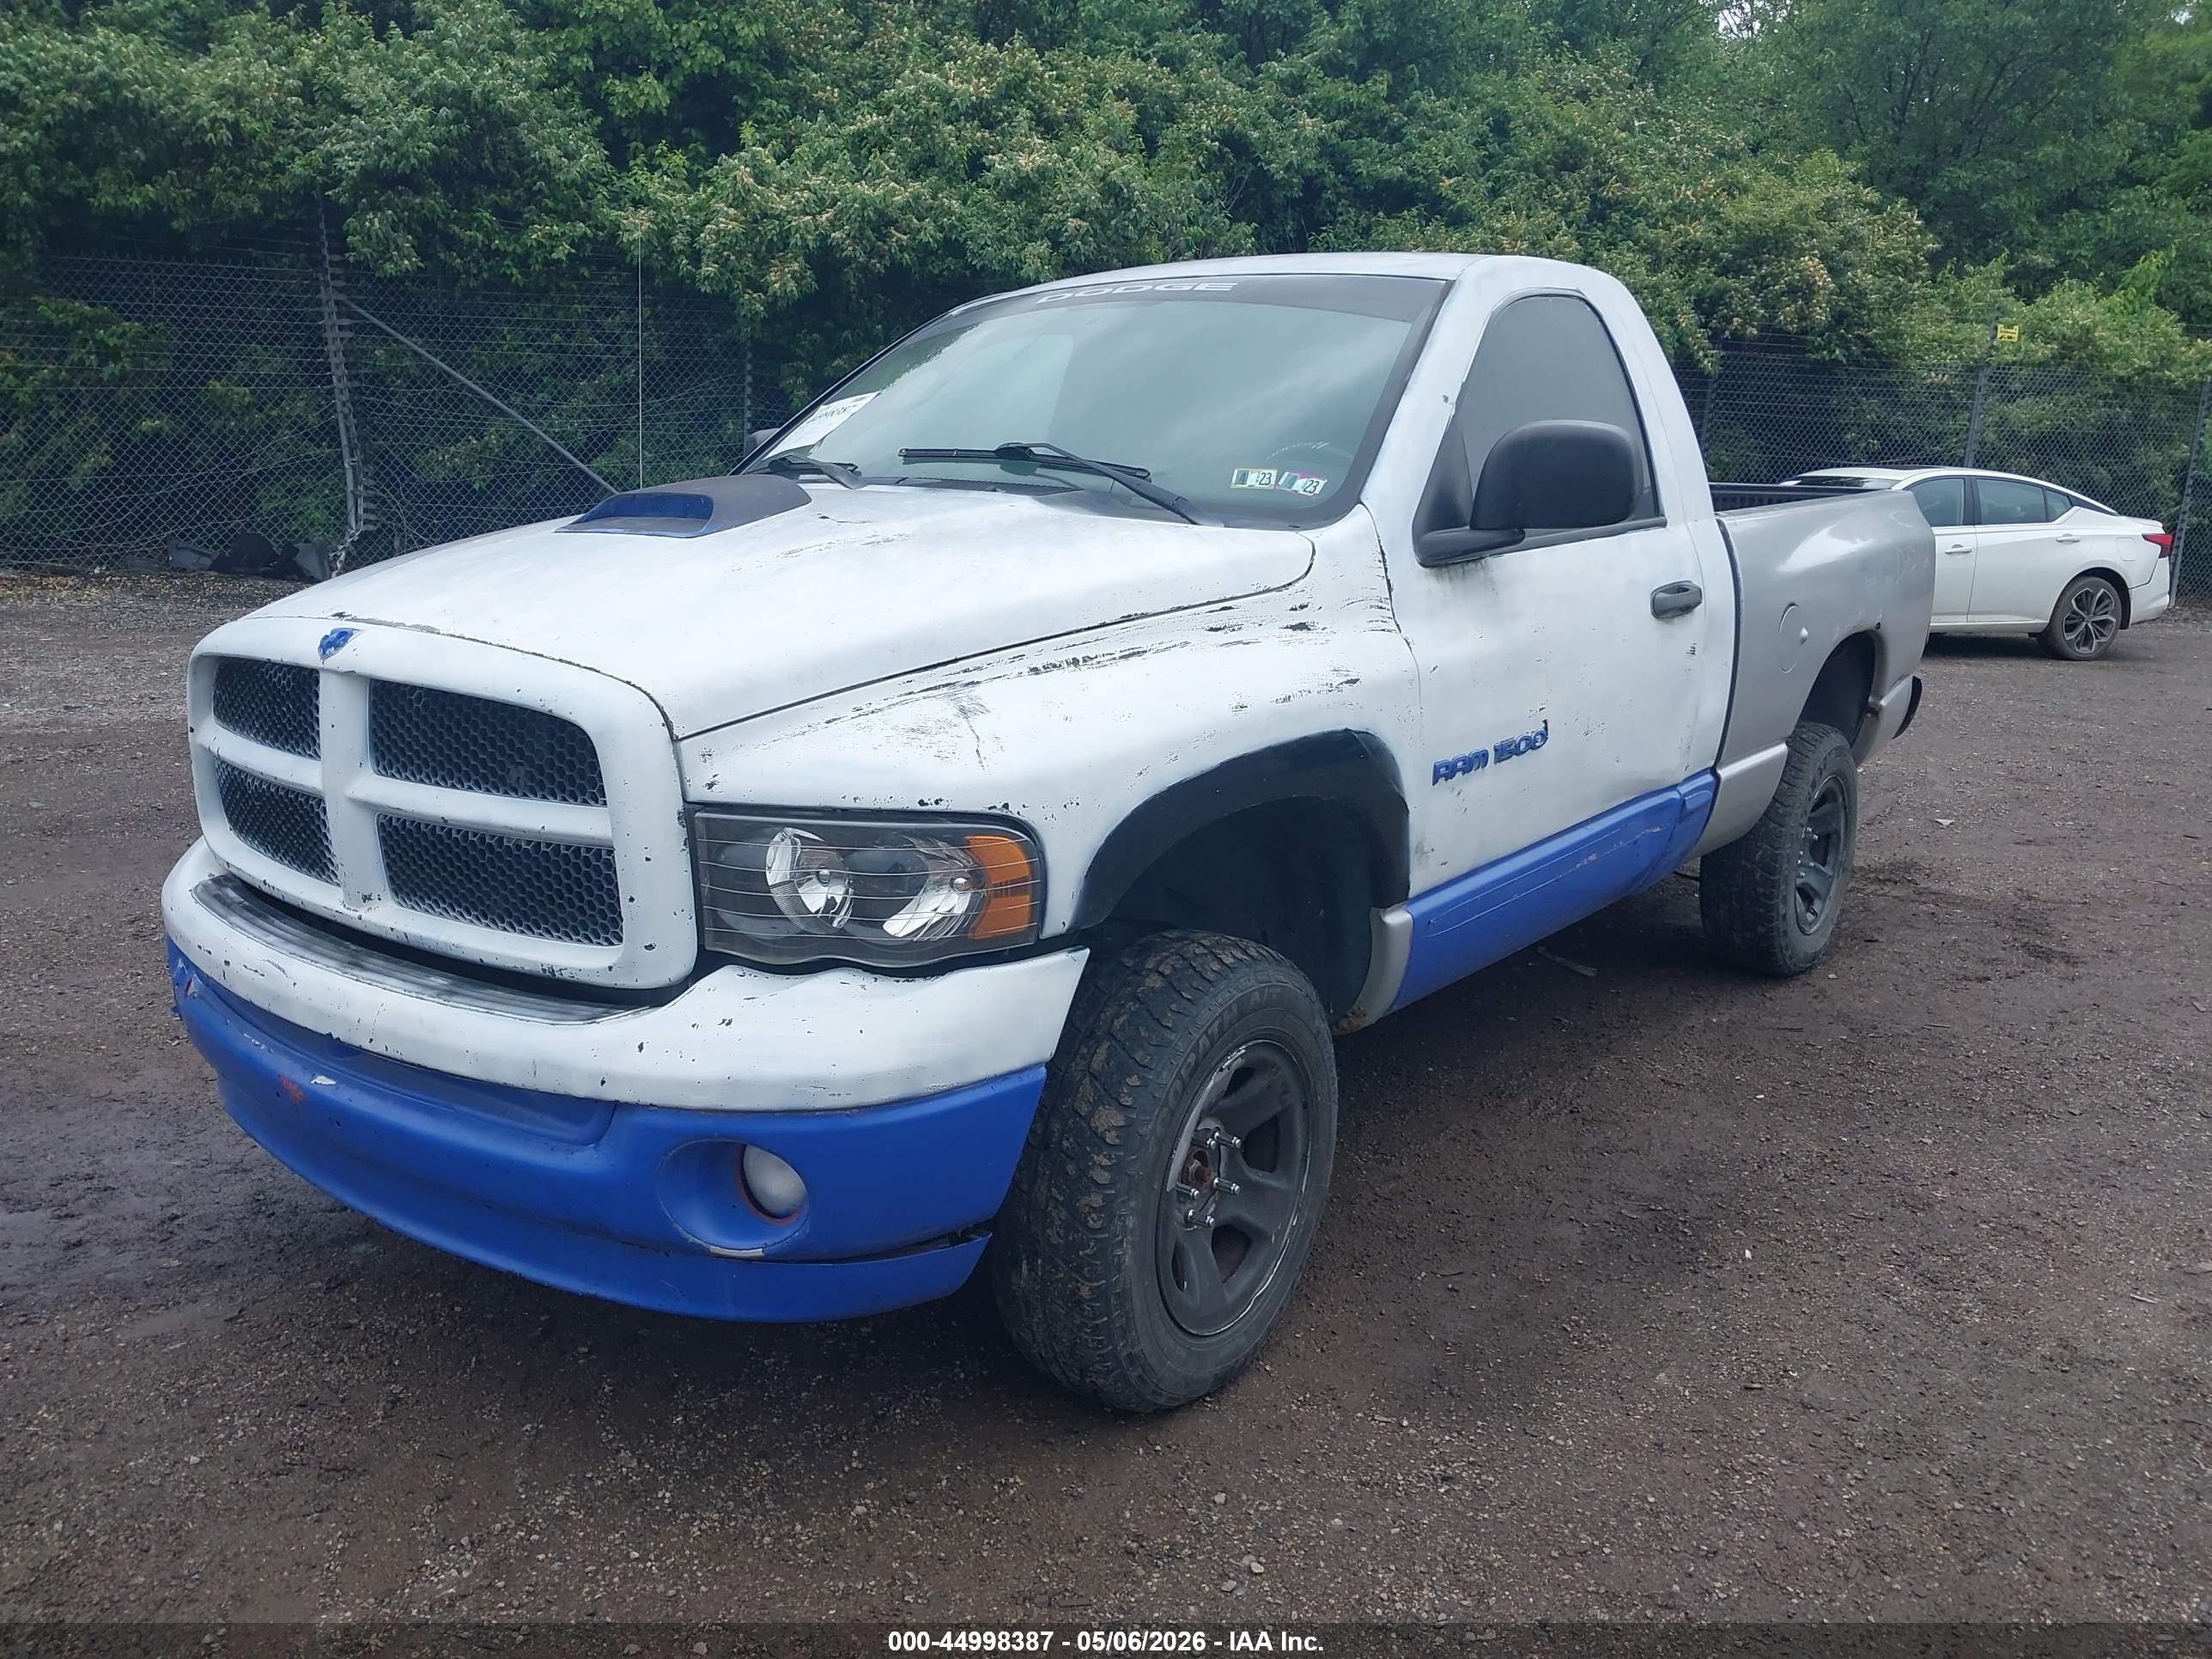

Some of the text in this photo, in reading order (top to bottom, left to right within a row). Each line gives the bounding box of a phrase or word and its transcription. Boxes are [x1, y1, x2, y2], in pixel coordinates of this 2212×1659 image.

[1036, 283, 1237, 304] DODGE
[1303, 479, 1320, 494] 23
[1432, 729, 1548, 786] RAM 1500
